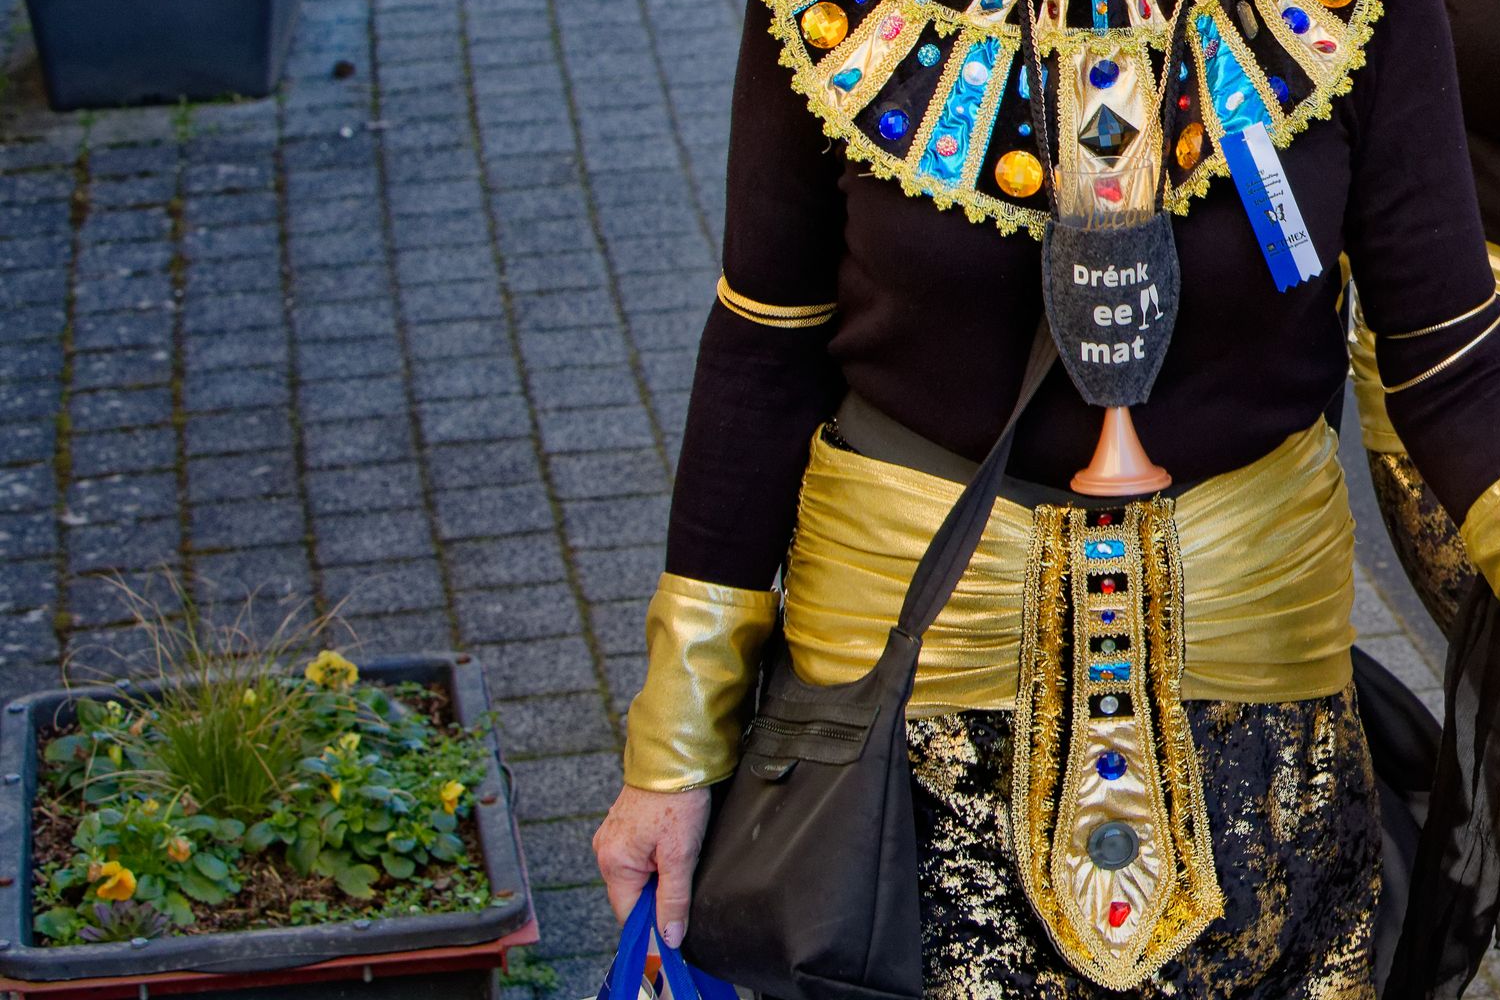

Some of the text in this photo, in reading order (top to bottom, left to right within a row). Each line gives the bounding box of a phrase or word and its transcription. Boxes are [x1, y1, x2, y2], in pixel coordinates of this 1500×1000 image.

[1073, 262, 1149, 288] Drénk
[1093, 304, 1133, 326] ee
[1081, 335, 1145, 364] mat
